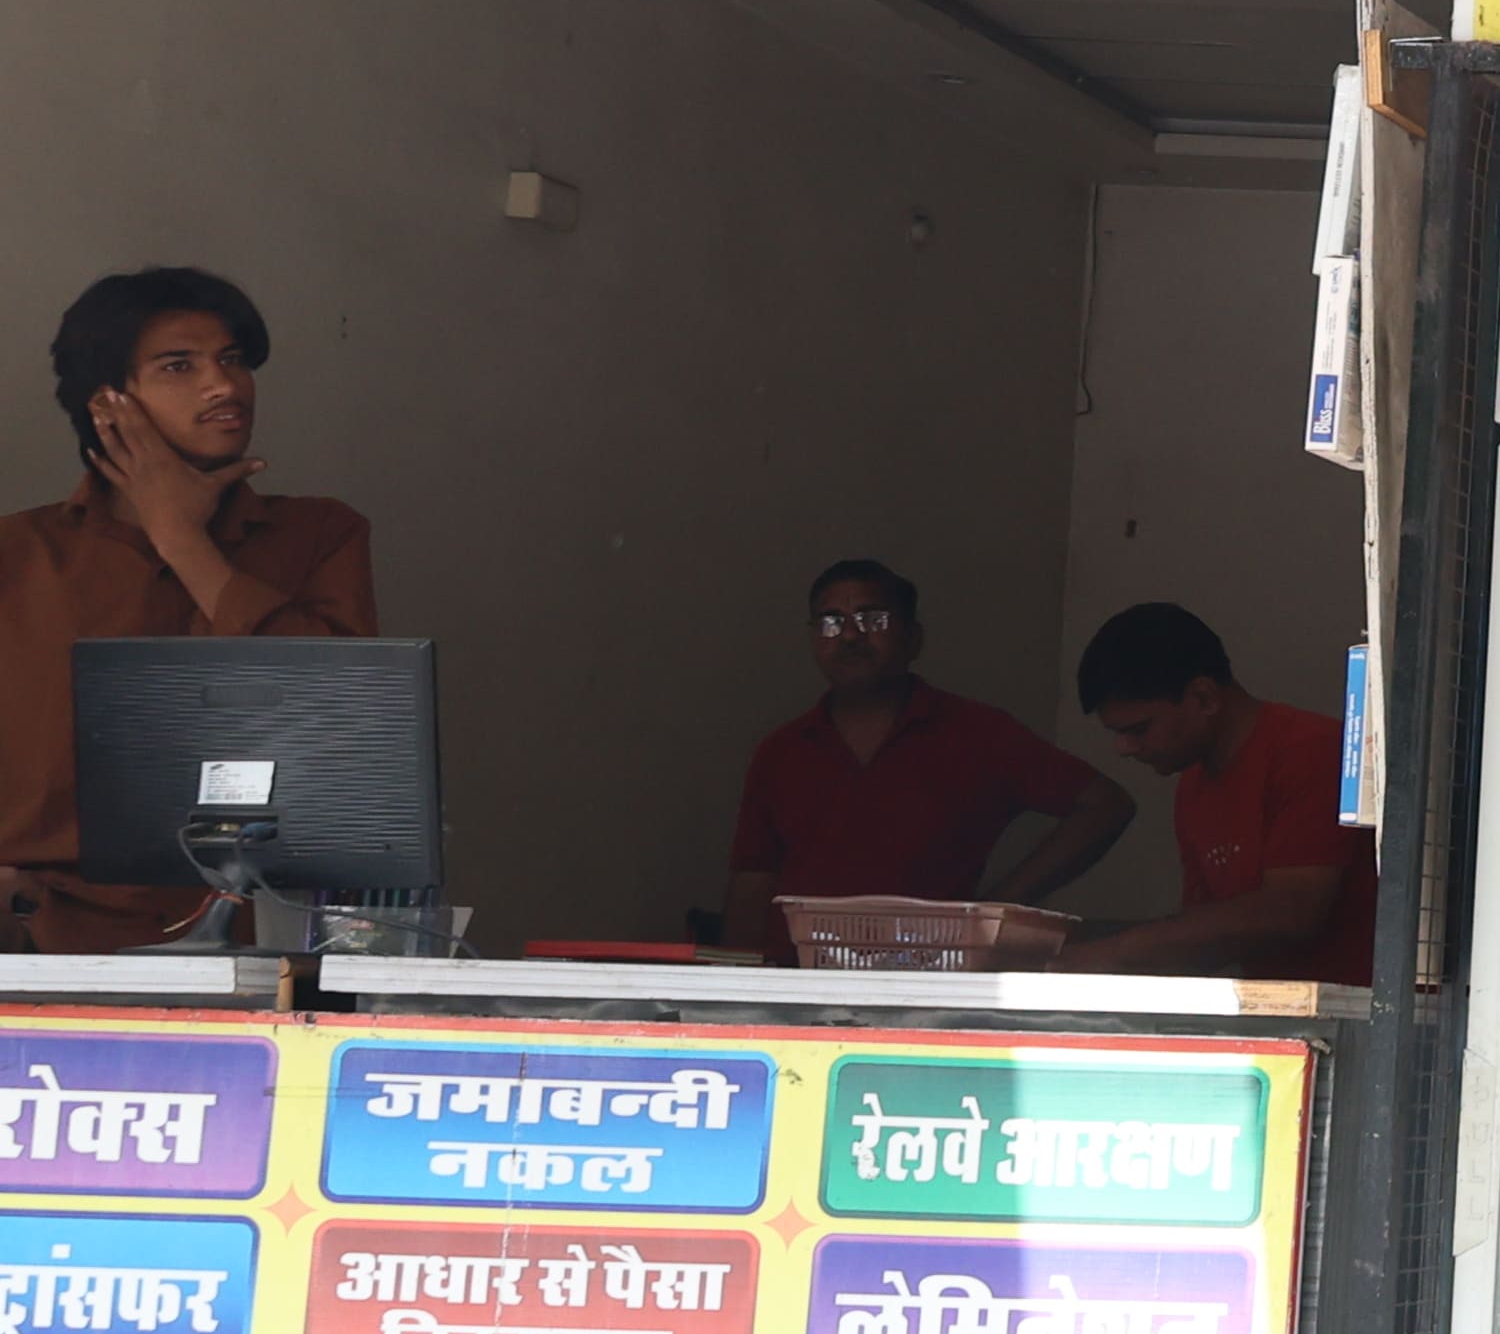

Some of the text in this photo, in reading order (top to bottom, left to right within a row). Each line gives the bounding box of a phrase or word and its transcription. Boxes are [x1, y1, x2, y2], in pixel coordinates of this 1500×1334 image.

[364, 1069, 739, 1129] जमाबन्दी
[427, 1140, 664, 1193] नकल
[851, 1092, 1240, 1191] रेलवे आरक्षण
[336, 1244, 731, 1312] आधार से पैसा
